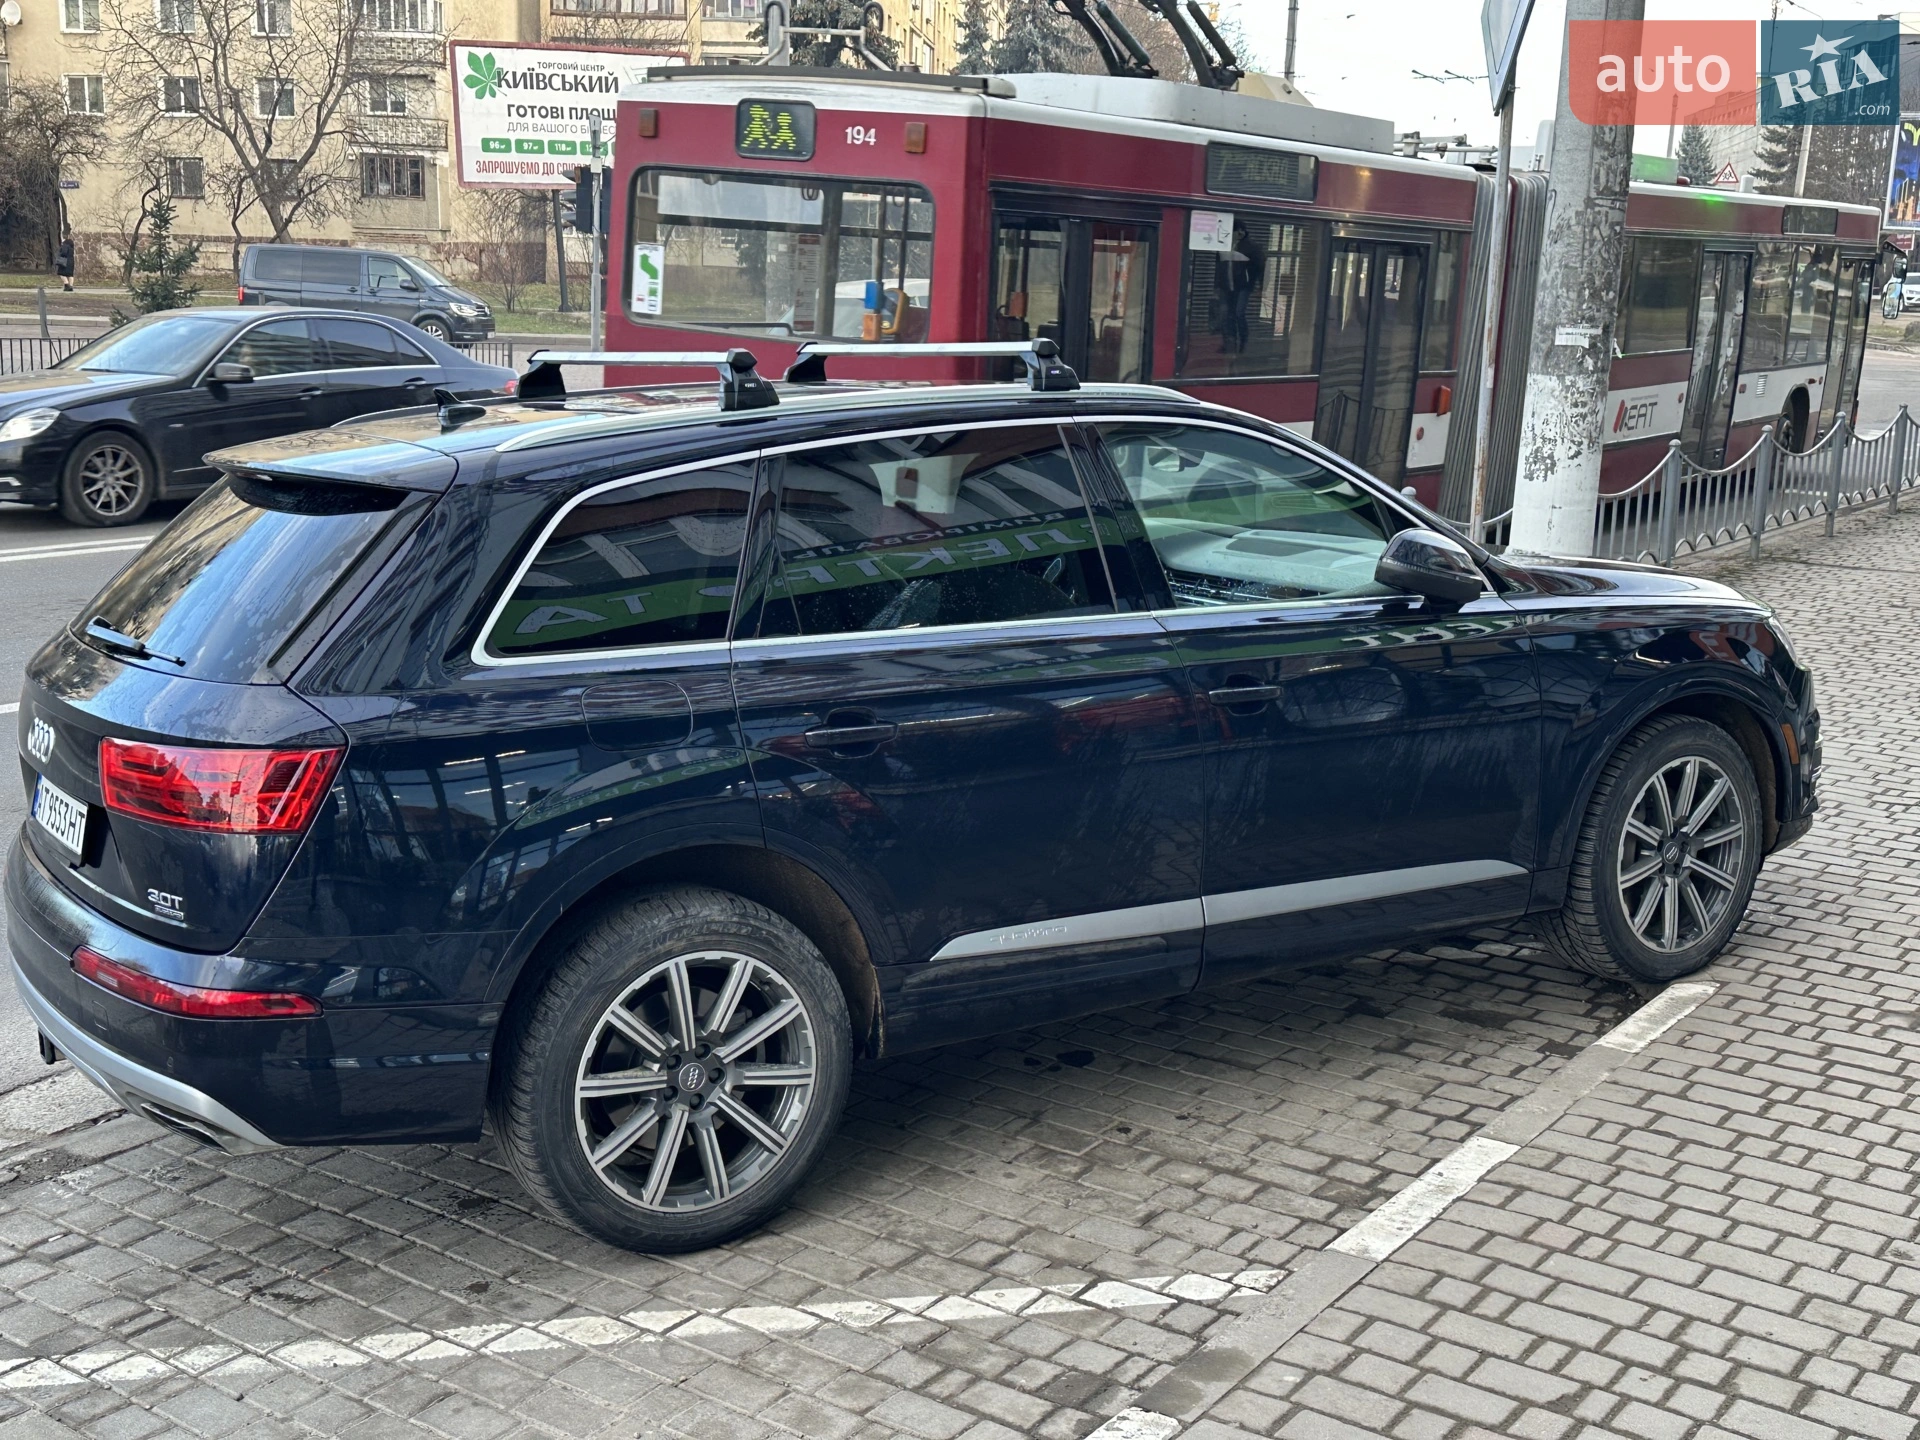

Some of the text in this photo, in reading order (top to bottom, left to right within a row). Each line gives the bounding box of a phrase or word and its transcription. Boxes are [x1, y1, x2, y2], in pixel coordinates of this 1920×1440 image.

[537, 61, 605, 72] ТОРГОВИЙ ЦЕНТР
[496, 67, 619, 94] КИЇВСЬКИЙ
[507, 104, 565, 120] ГОТОВІ
[507, 122, 530, 133] ДЛЯ
[532, 123, 578, 134] ВАШОГО
[845, 126, 877, 146] 194
[475, 160, 540, 176] ЗАПРОШУЄМО
[542, 163, 555, 176] ДО
